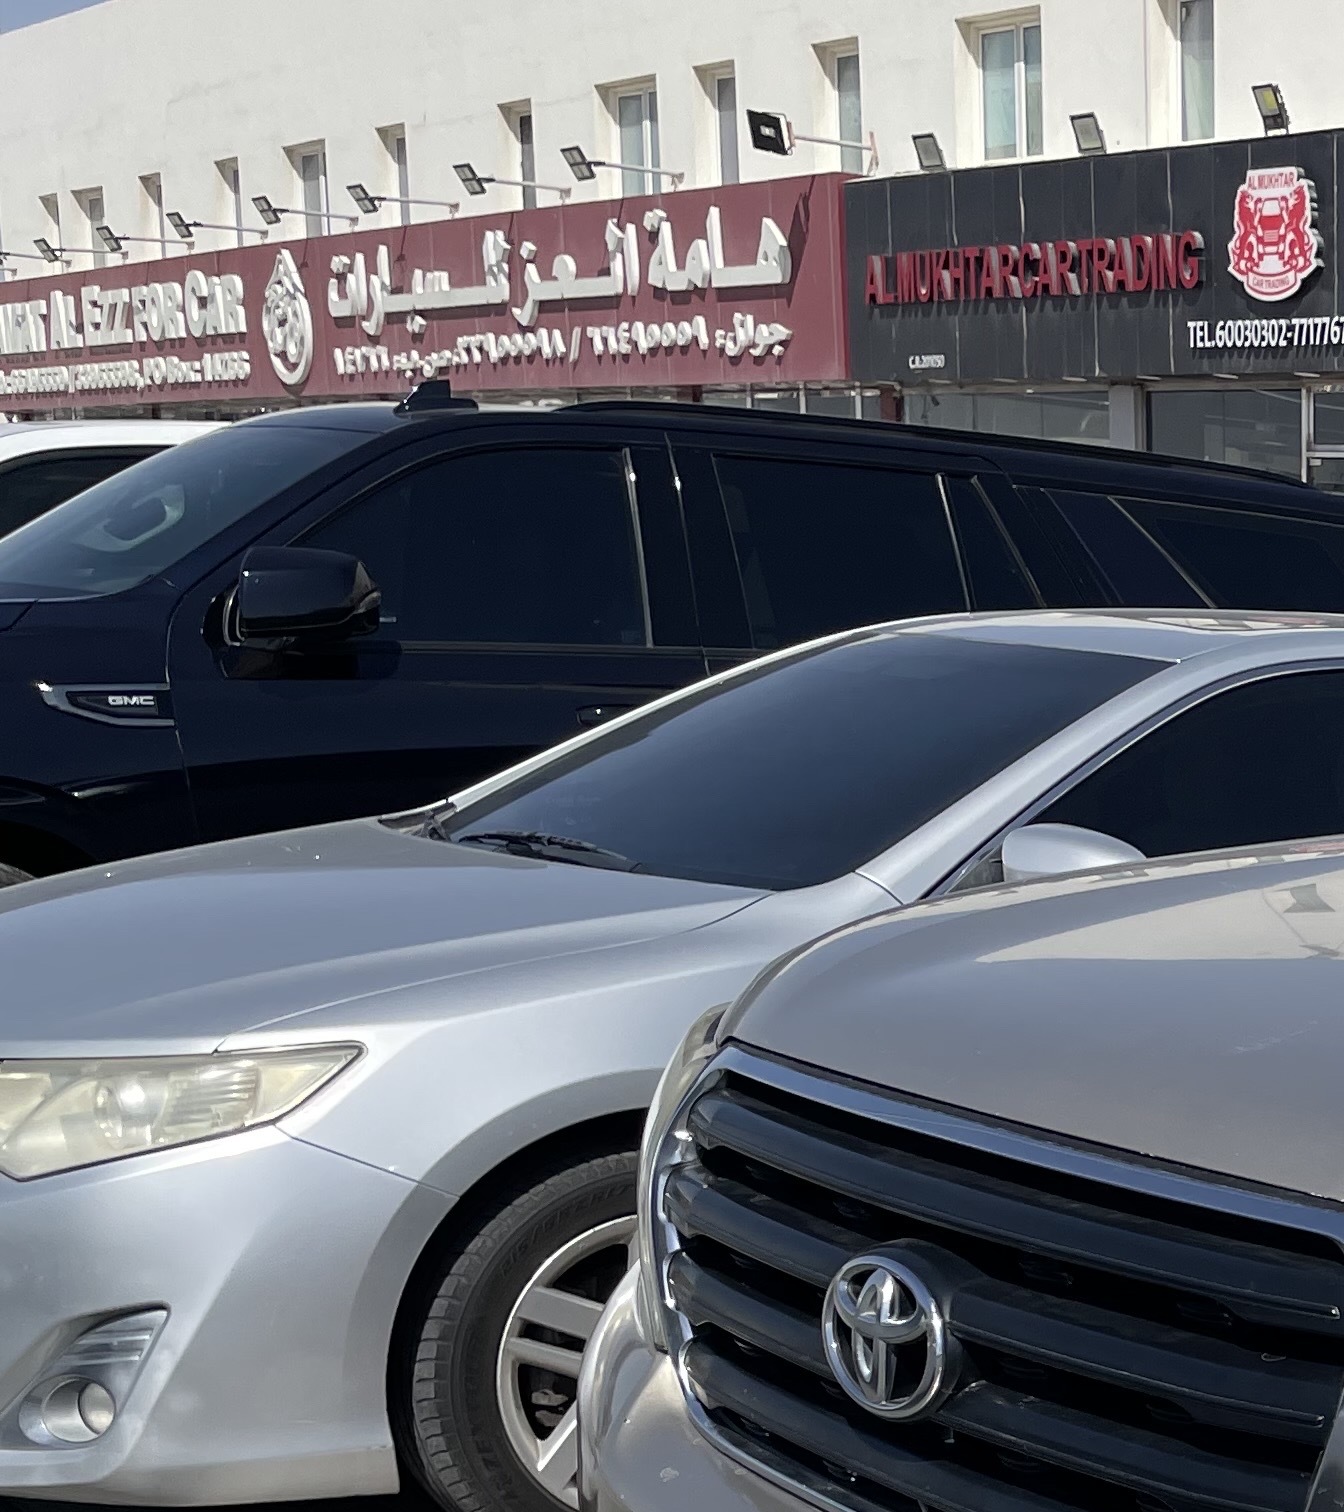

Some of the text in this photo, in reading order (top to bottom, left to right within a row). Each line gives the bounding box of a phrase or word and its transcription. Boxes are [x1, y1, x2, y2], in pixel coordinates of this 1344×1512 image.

[645, 205, 793, 292] هامة
[1076, 231, 1206, 294] TRADING
[107, 695, 155, 706] GMC
